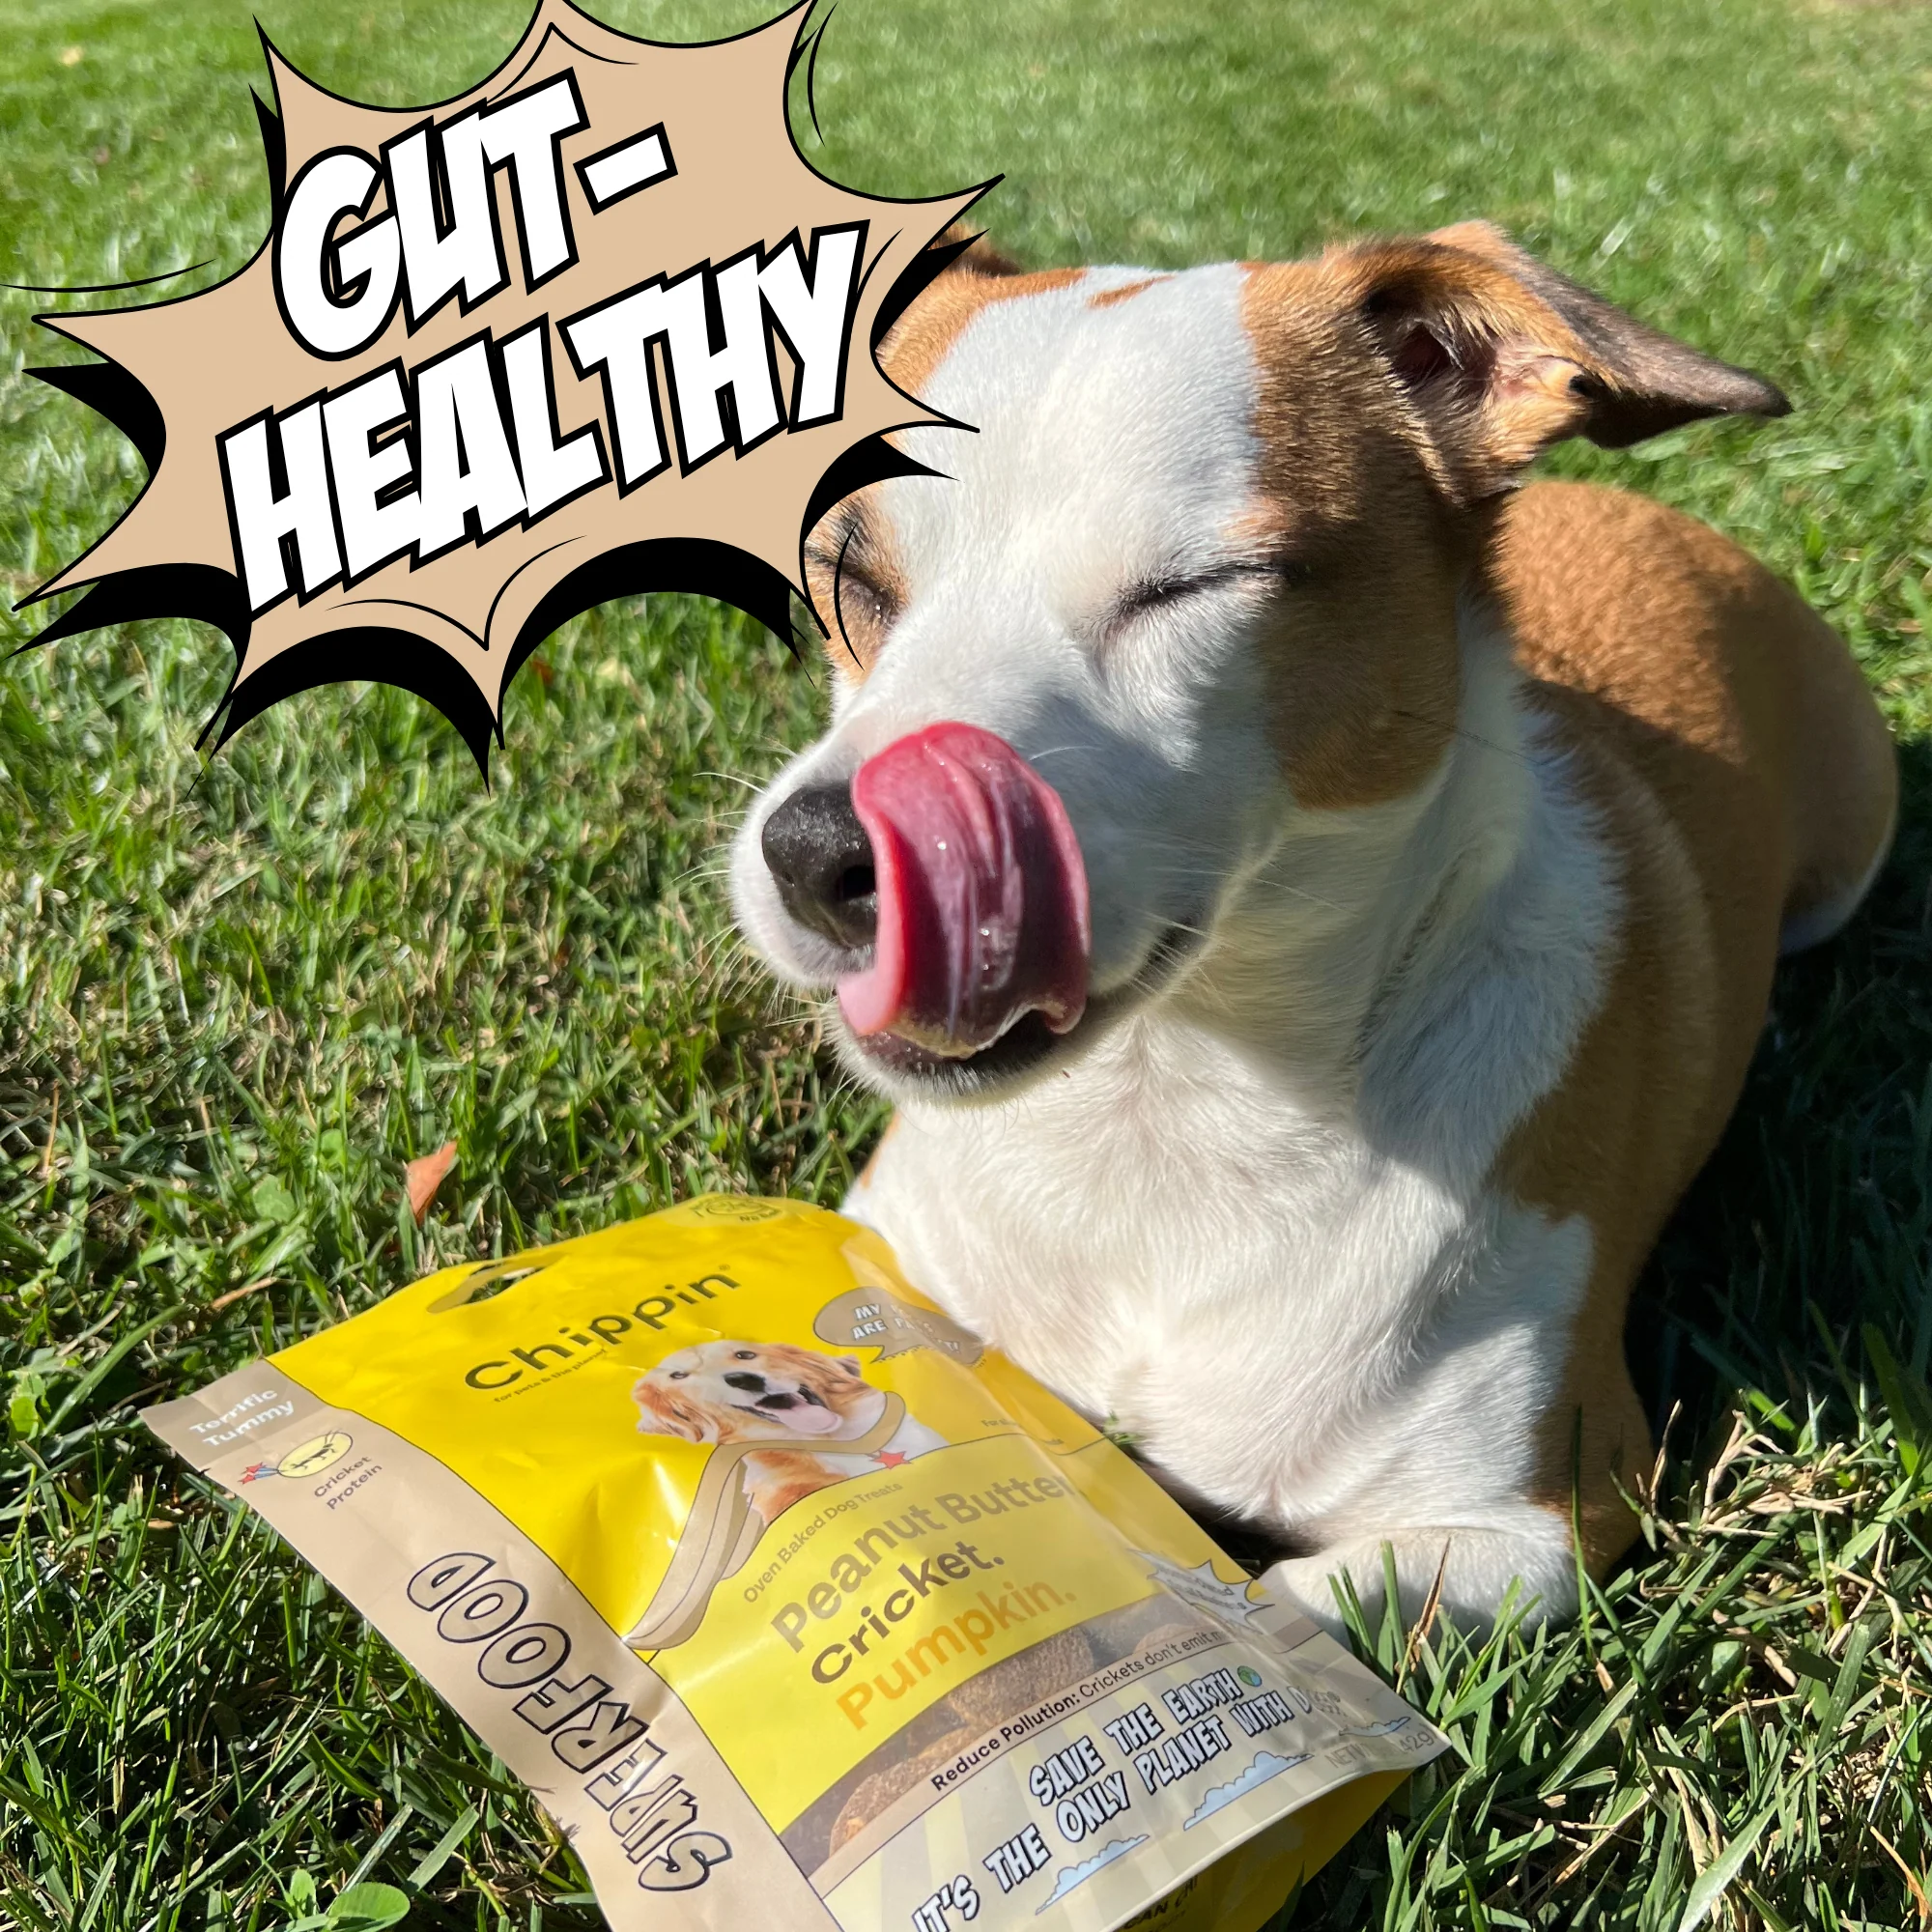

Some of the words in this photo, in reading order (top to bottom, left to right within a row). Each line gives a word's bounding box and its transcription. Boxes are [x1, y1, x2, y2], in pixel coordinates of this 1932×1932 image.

[465, 1273, 741, 1389] Chippin
[851, 1319, 888, 1341] ARE
[855, 1303, 881, 1321] MY
[189, 1389, 278, 1435] Terrific
[203, 1400, 295, 1447] Tummy
[494, 1392, 512, 1402] for
[513, 1383, 542, 1396] pets
[551, 1368, 573, 1378] the
[573, 1348, 608, 1371] planet
[314, 1456, 372, 1497] Cricket
[327, 1464, 383, 1510] Protein
[744, 1562, 782, 1603] Oven
[777, 1515, 826, 1563] Baked
[823, 1499, 859, 1520] Dog
[854, 1482, 903, 1503] Treats
[771, 1504, 948, 1654] Peanut
[811, 1541, 1005, 1684] Cricket.
[836, 1580, 1077, 1732] Pumpkin.
[407, 1552, 732, 1891] SUPERFOOD
[930, 1736, 1001, 1791] Reduce
[1000, 1692, 1081, 1742] Pollution:
[1079, 1659, 1144, 1698] Crickets
[1145, 1641, 1182, 1665] don't
[1181, 1631, 1215, 1651] emit
[1029, 1736, 1106, 1805] SAVE
[1103, 1702, 1165, 1756] THE
[1161, 1667, 1244, 1725] EARTH
[911, 1874, 980, 1932] IT'S
[982, 1823, 1053, 1893] THE
[1056, 1771, 1130, 1842] ONLY
[1133, 1715, 1233, 1795] PLANET
[1229, 1690, 1295, 1738] WITH
